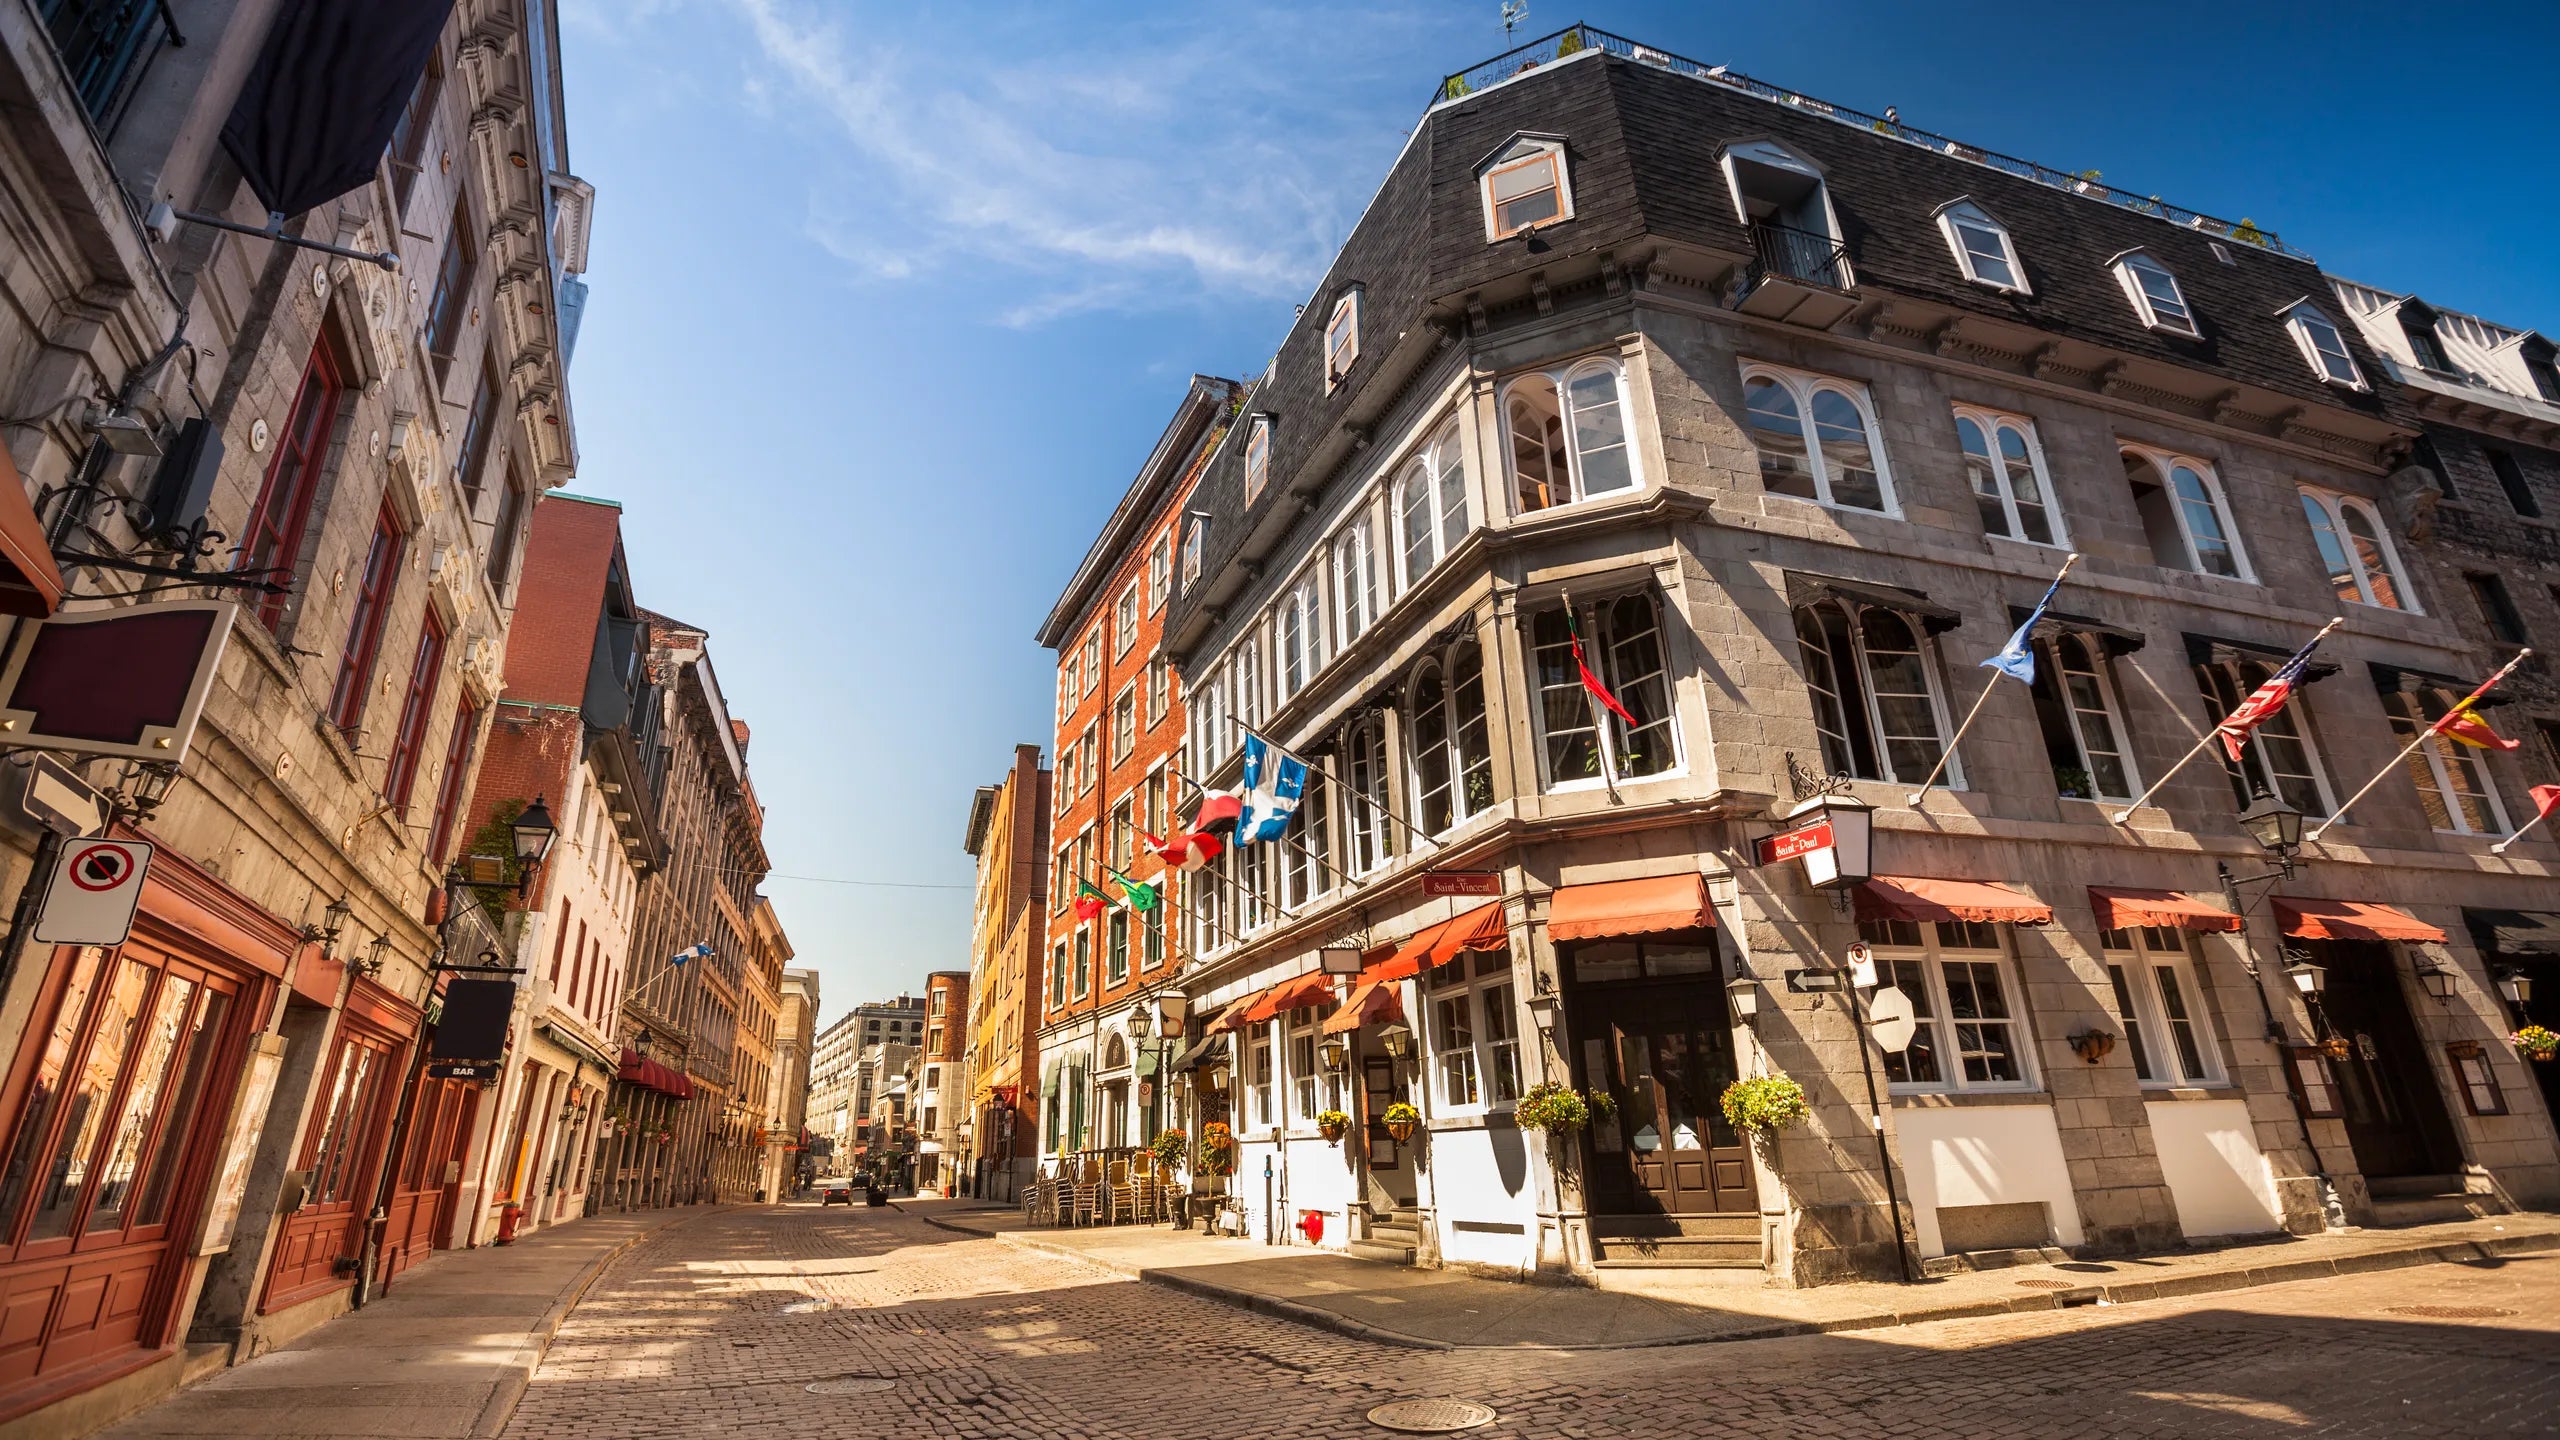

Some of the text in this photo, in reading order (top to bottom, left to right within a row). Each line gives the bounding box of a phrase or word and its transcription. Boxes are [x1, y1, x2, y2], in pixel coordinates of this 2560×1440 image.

[1776, 835, 1818, 857] Saint-Paul
[1433, 882, 1491, 892] Saint-Vincent
[452, 1067, 474, 1075] BAR
